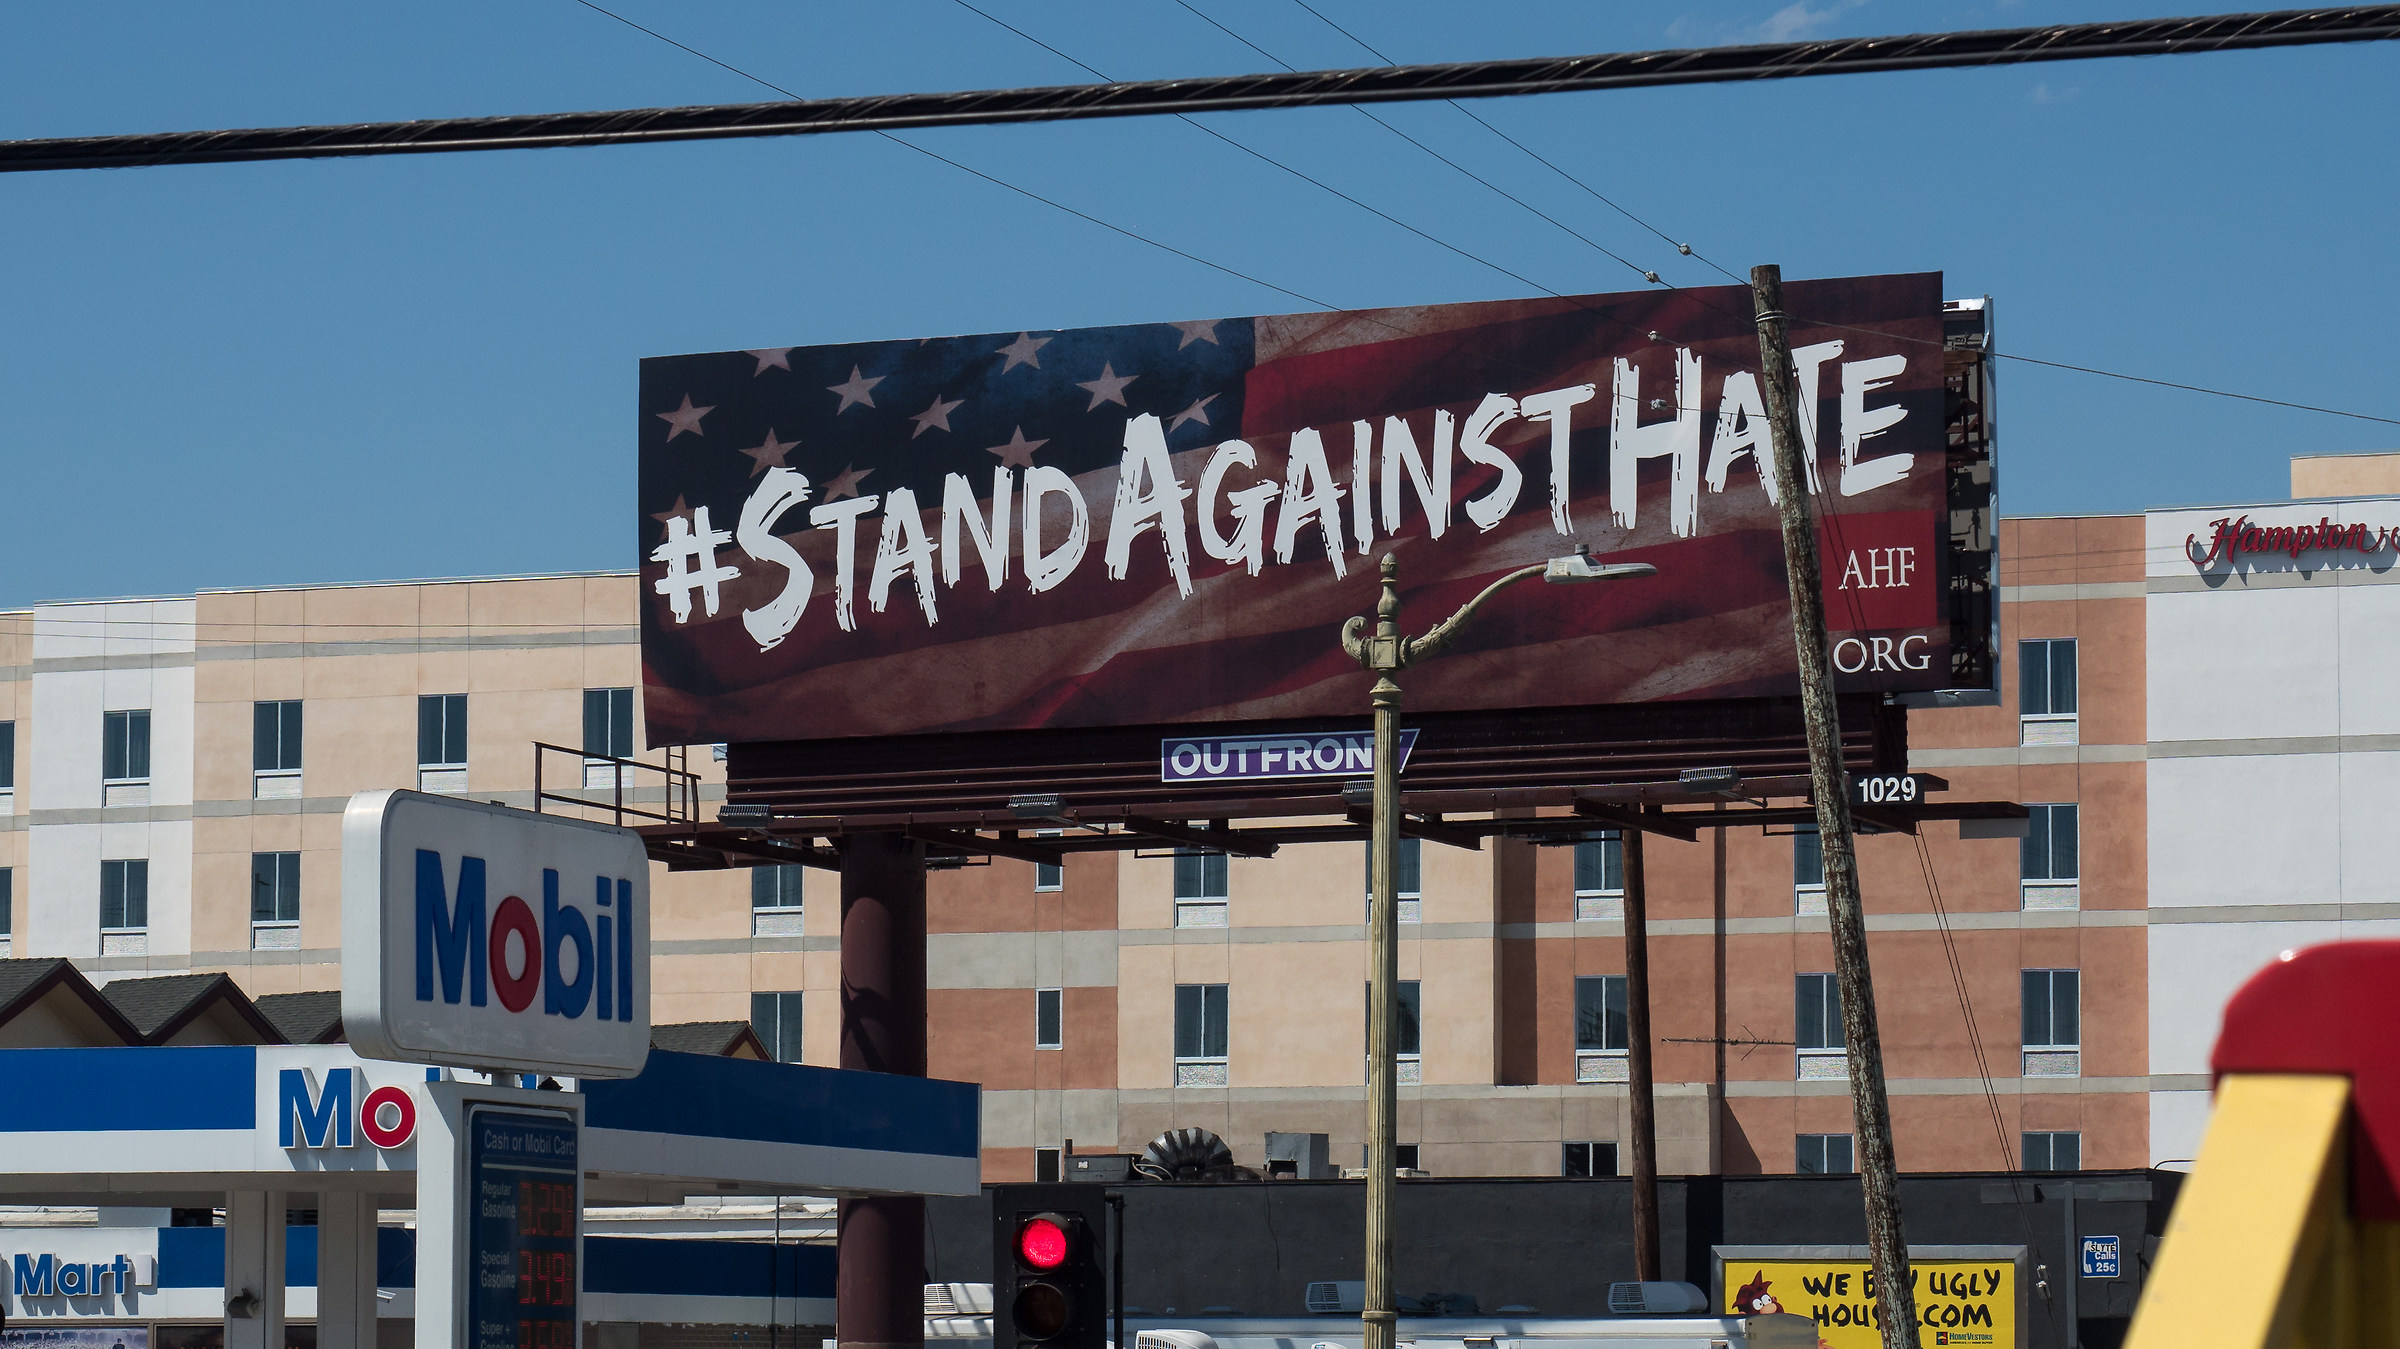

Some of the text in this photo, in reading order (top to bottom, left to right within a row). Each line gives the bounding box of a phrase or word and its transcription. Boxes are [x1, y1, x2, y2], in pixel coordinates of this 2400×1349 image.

[2185, 514, 2384, 565] Hampton
[1838, 546, 1915, 589] AHF
[1833, 635, 1931, 673] ORG
[1171, 736, 1403, 776] OUTFRON
[1858, 777, 1916, 803] 1029
[415, 848, 633, 1023] Mobil
[484, 1129, 575, 1155] Cash or Mobil Card
[481, 1180, 512, 1198] Regular
[481, 1199, 516, 1219] Gasoline
[481, 1250, 510, 1267] Special
[2094, 1251, 2116, 1260] Calls
[13, 1253, 131, 1296] Mart
[481, 1269, 516, 1289] Gasoline
[1802, 1271, 1851, 1296] WE
[1929, 1268, 2001, 1300] UGLY
[480, 1320, 503, 1338] Super
